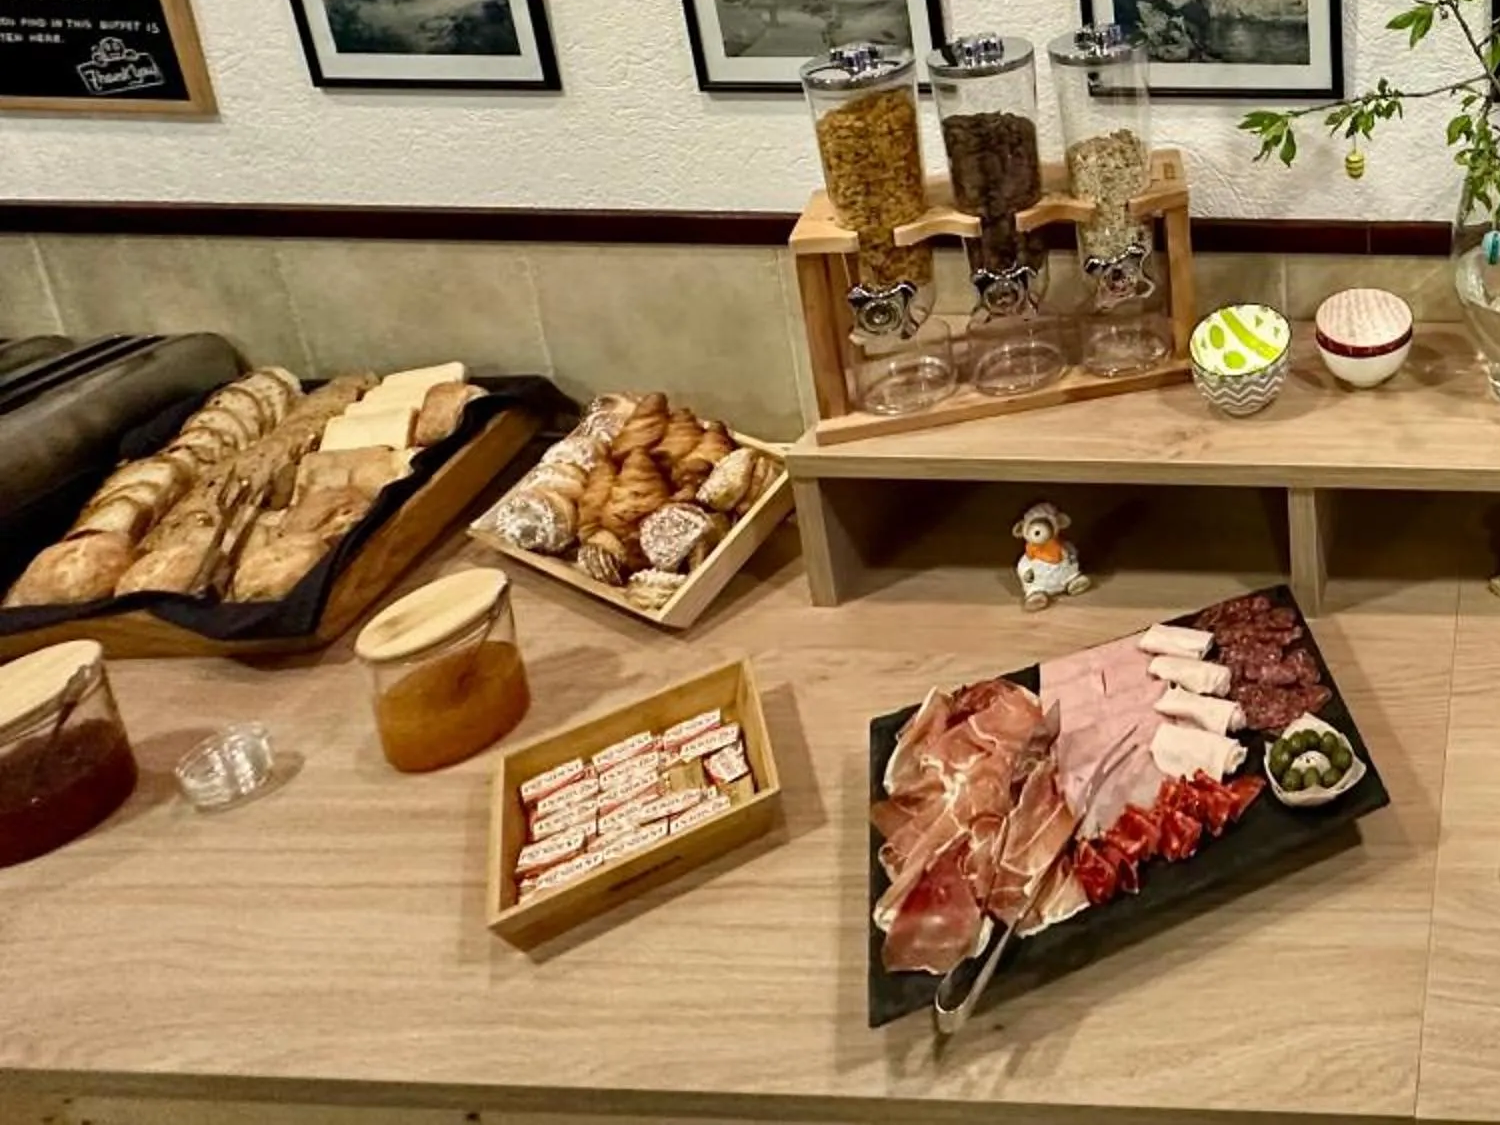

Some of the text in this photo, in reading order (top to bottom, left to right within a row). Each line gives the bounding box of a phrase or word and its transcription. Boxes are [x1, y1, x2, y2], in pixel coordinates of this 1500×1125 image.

[51, 18, 63, 28] IN
[66, 18, 92, 29] THIS
[99, 20, 141, 32] BUFFET
[146, 22, 161, 34] IS
